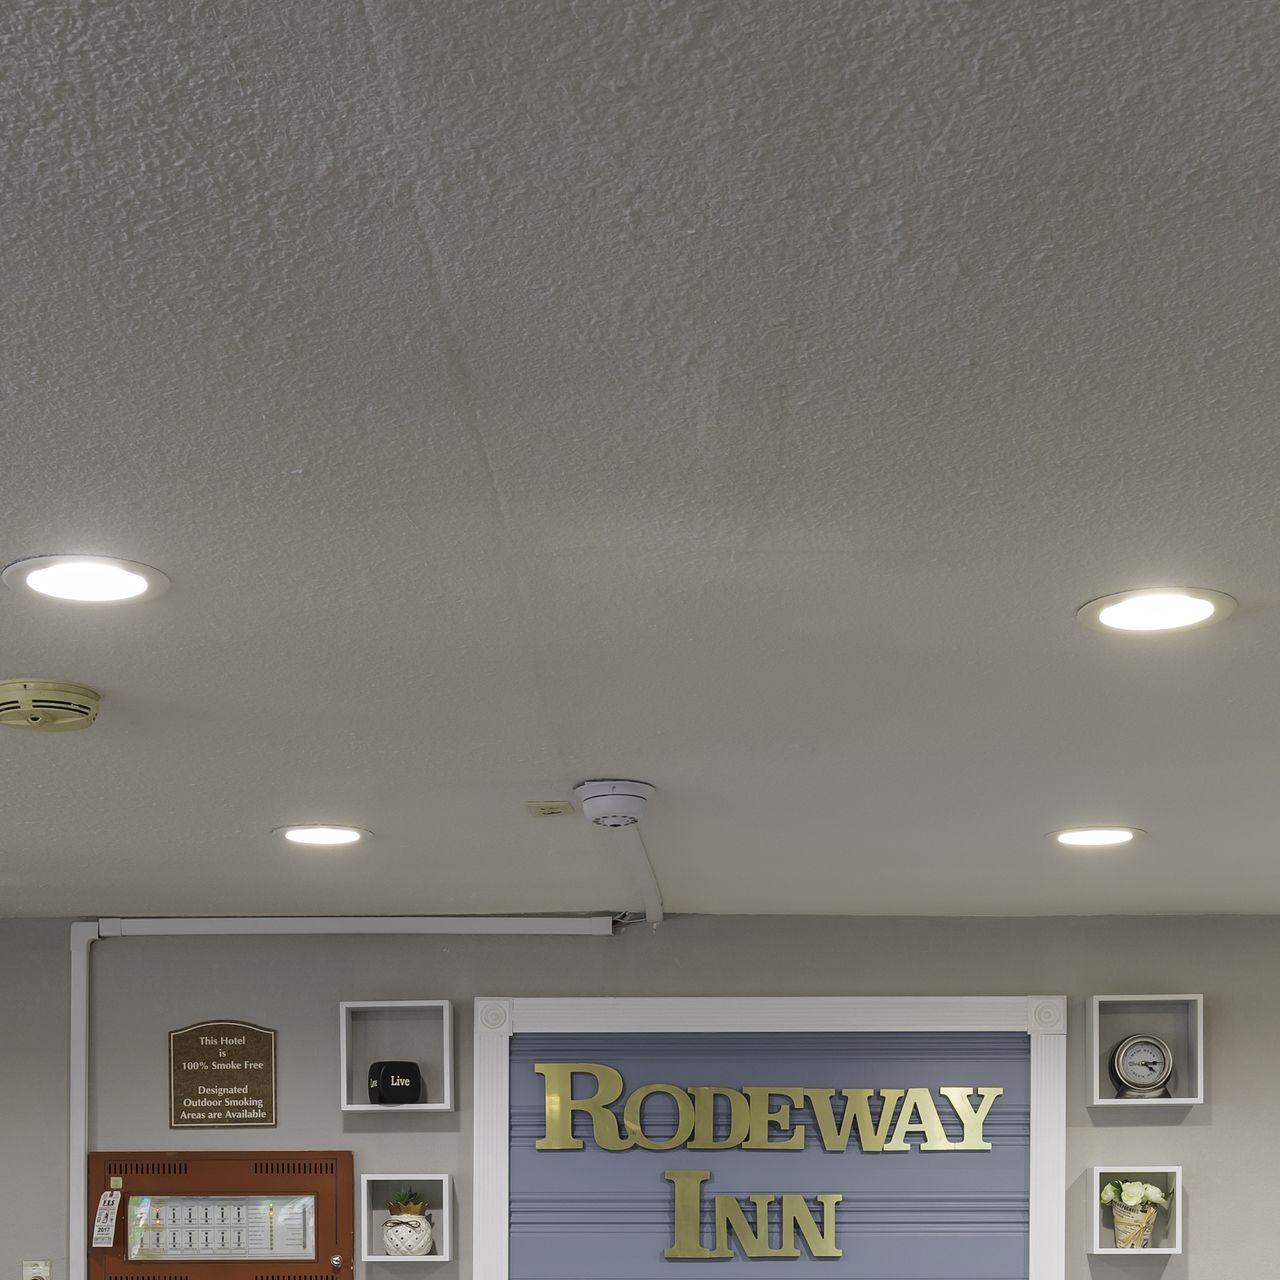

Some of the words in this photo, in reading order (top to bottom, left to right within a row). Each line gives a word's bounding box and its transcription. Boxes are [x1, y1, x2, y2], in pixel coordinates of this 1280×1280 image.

[200, 1036, 218, 1045] This
[220, 1036, 246, 1045] Hotel
[219, 1049, 226, 1057] is
[182, 1062, 209, 1070] 100%
[211, 1061, 242, 1070] Smoke
[244, 1061, 264, 1069] Free
[390, 1076, 410, 1086] Live
[198, 1085, 248, 1096] Designated
[183, 1098, 222, 1106] Outdoor
[224, 1097, 264, 1108] Smoking
[534, 1062, 1004, 1153] RODEWAY
[180, 1110, 206, 1119] Areas
[225, 1109, 267, 1119] Available
[663, 1168, 843, 1260] INN
